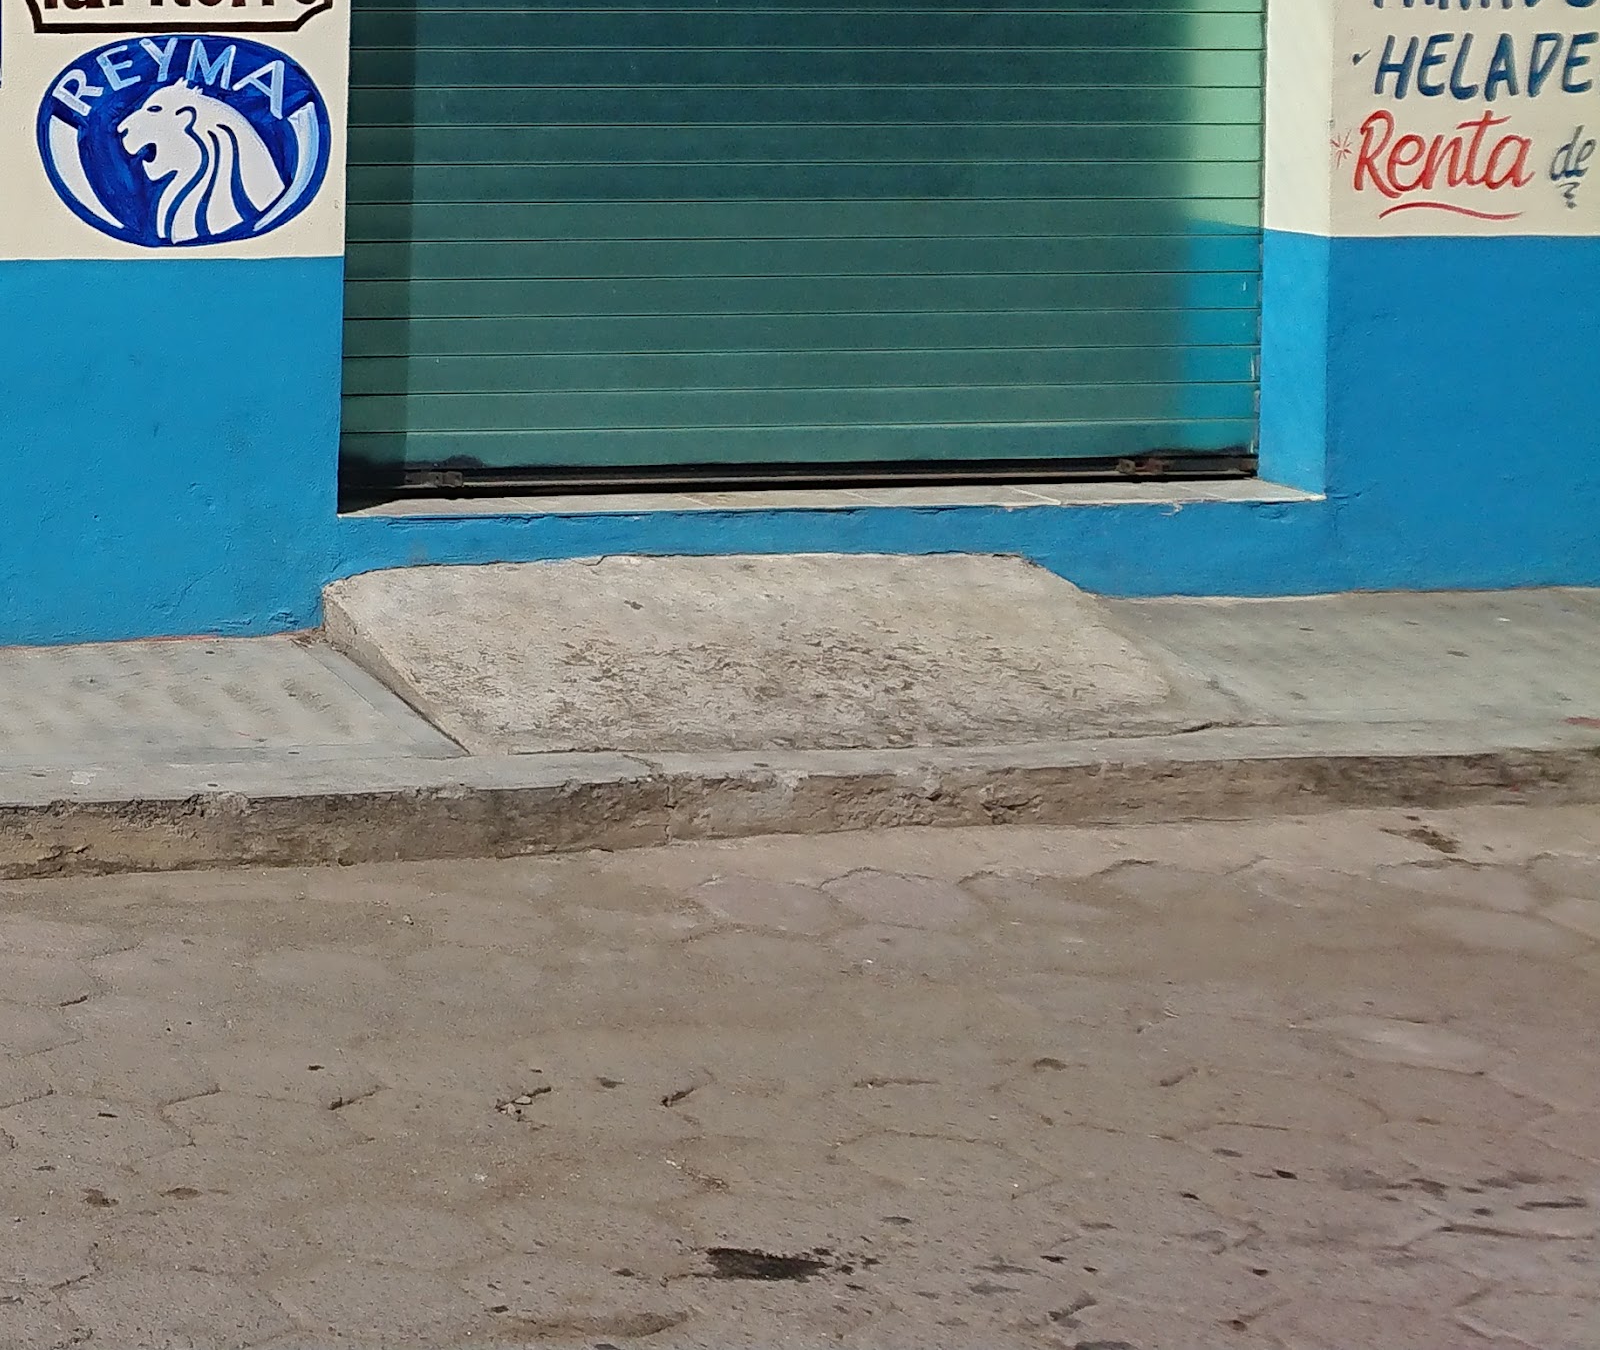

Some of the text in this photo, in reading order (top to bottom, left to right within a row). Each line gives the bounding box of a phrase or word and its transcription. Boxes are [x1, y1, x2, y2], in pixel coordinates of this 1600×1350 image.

[52, 37, 286, 120] REYMA
[1374, 32, 1599, 101] HELADE
[1353, 109, 1597, 200] Renta de
